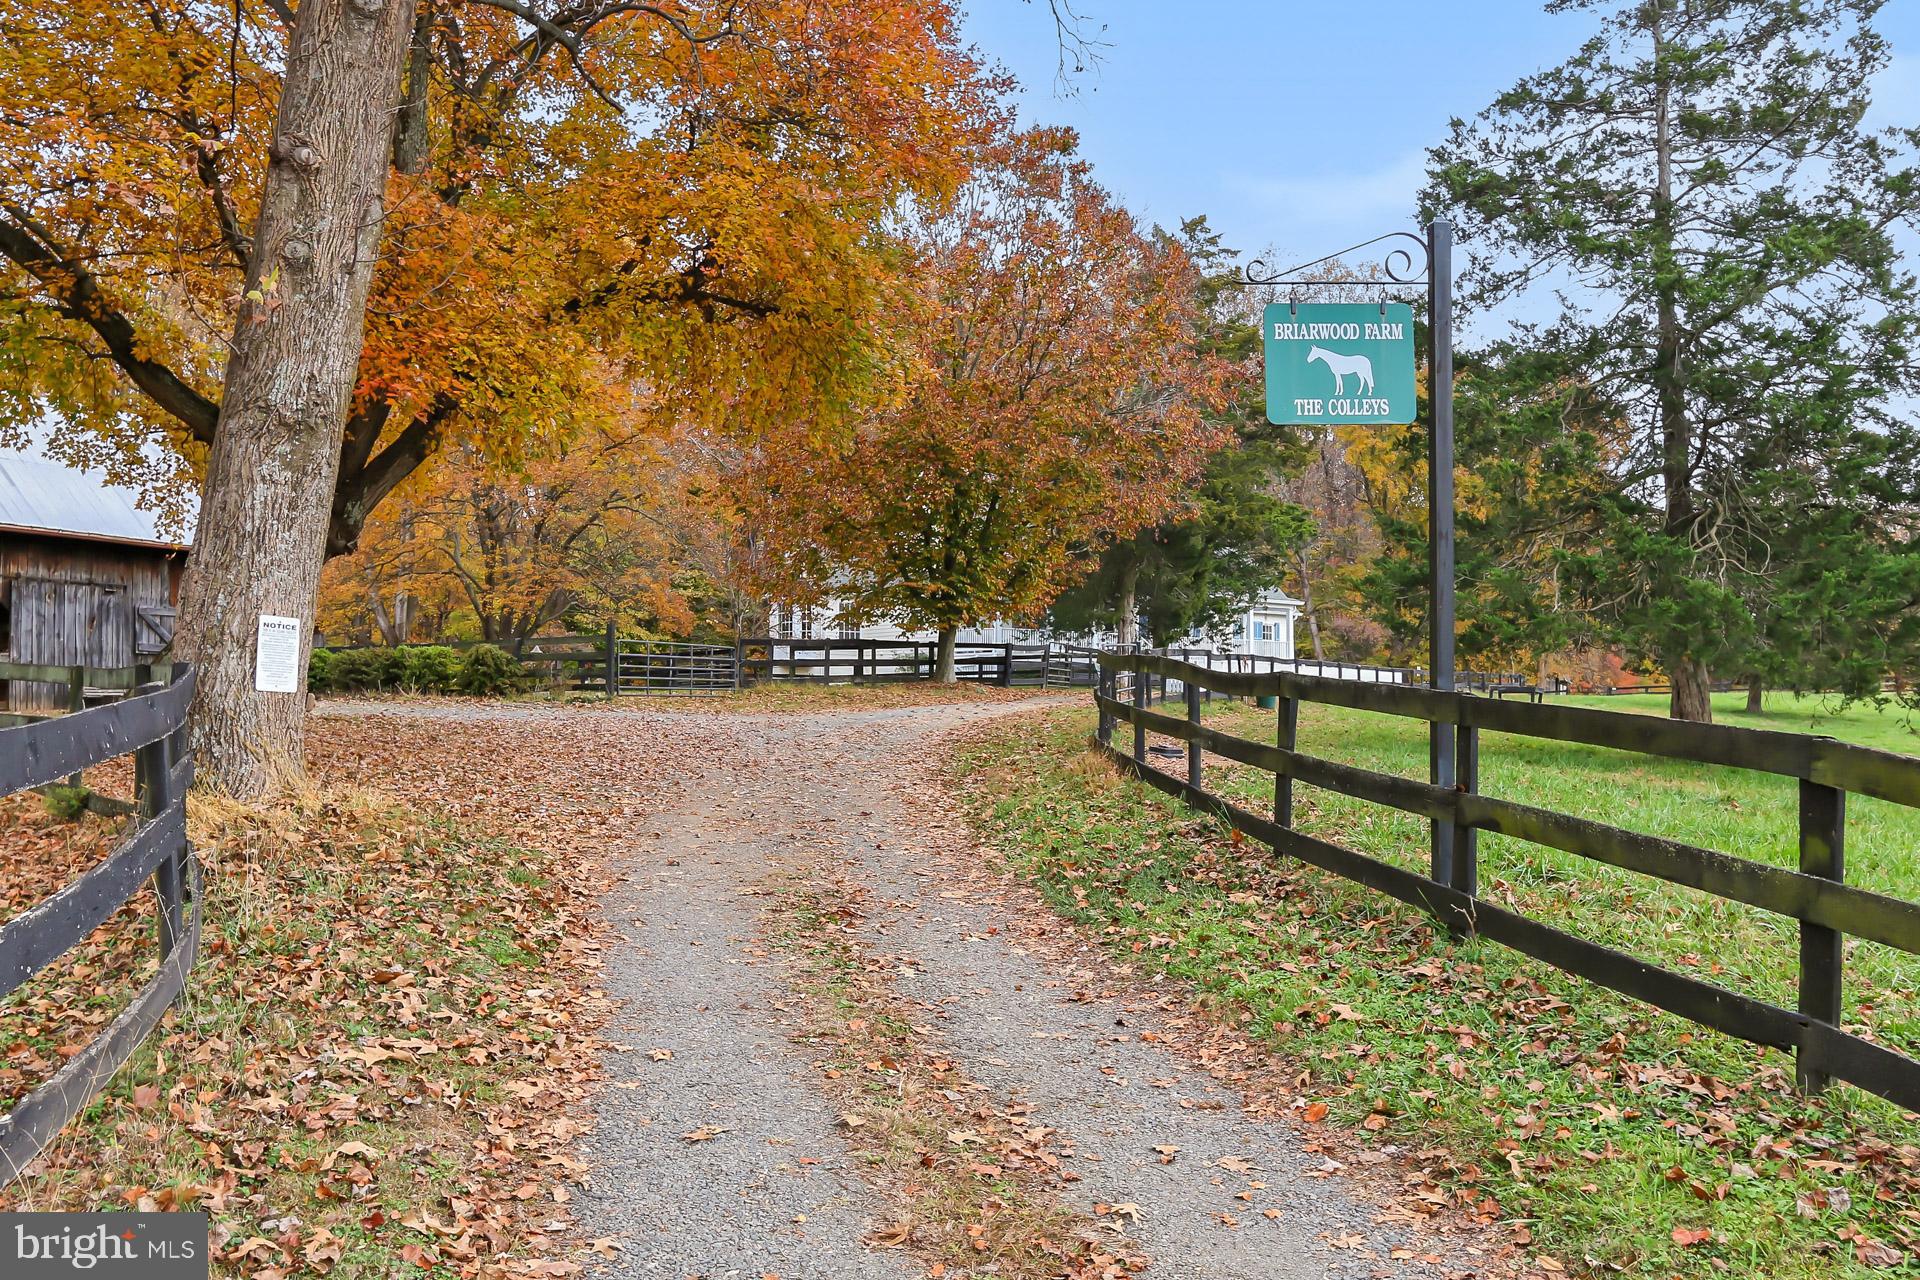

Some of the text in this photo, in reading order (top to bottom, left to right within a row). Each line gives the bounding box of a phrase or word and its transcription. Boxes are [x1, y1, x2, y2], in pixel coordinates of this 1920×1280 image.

[1274, 323, 1403, 340] BRIARWOOD FARM
[1294, 399, 1390, 416] THE COLLEYS
[263, 622, 297, 631] NOTICE
